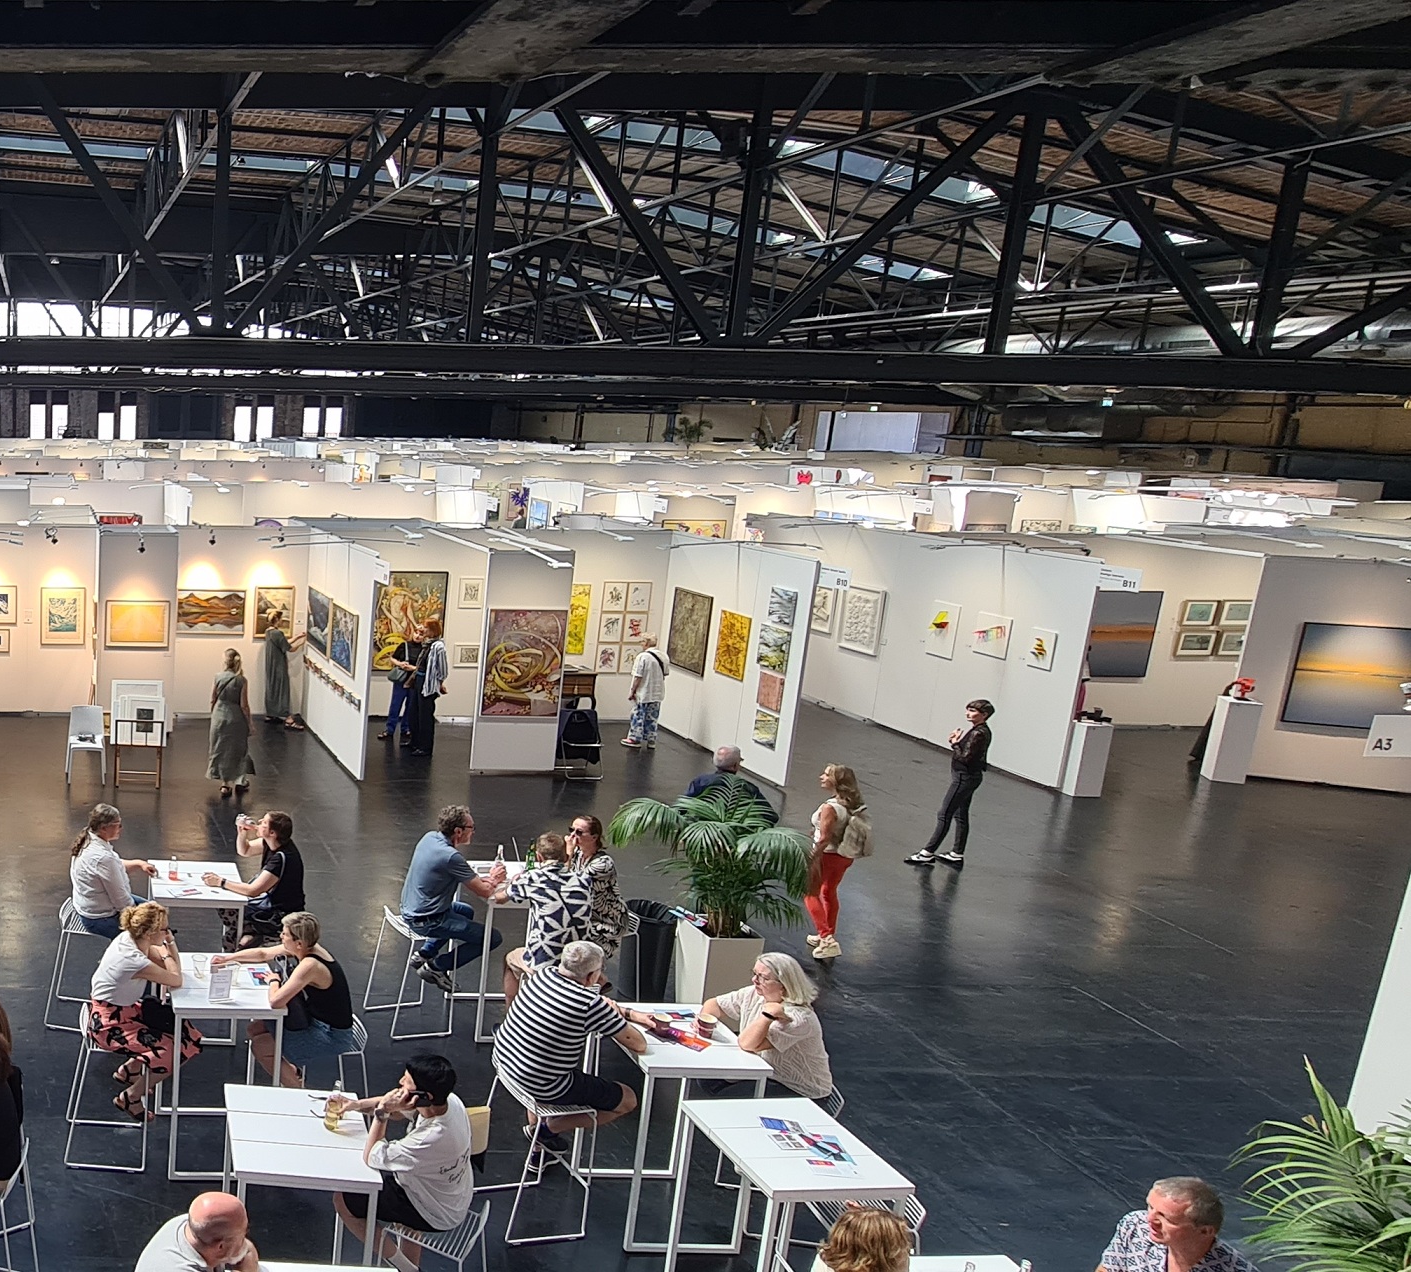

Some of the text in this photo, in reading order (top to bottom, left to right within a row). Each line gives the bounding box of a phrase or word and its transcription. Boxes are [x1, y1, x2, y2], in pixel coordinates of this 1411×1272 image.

[836, 578, 848, 587] B10
[1122, 579, 1137, 589] B11
[1371, 738, 1394, 751] A3
